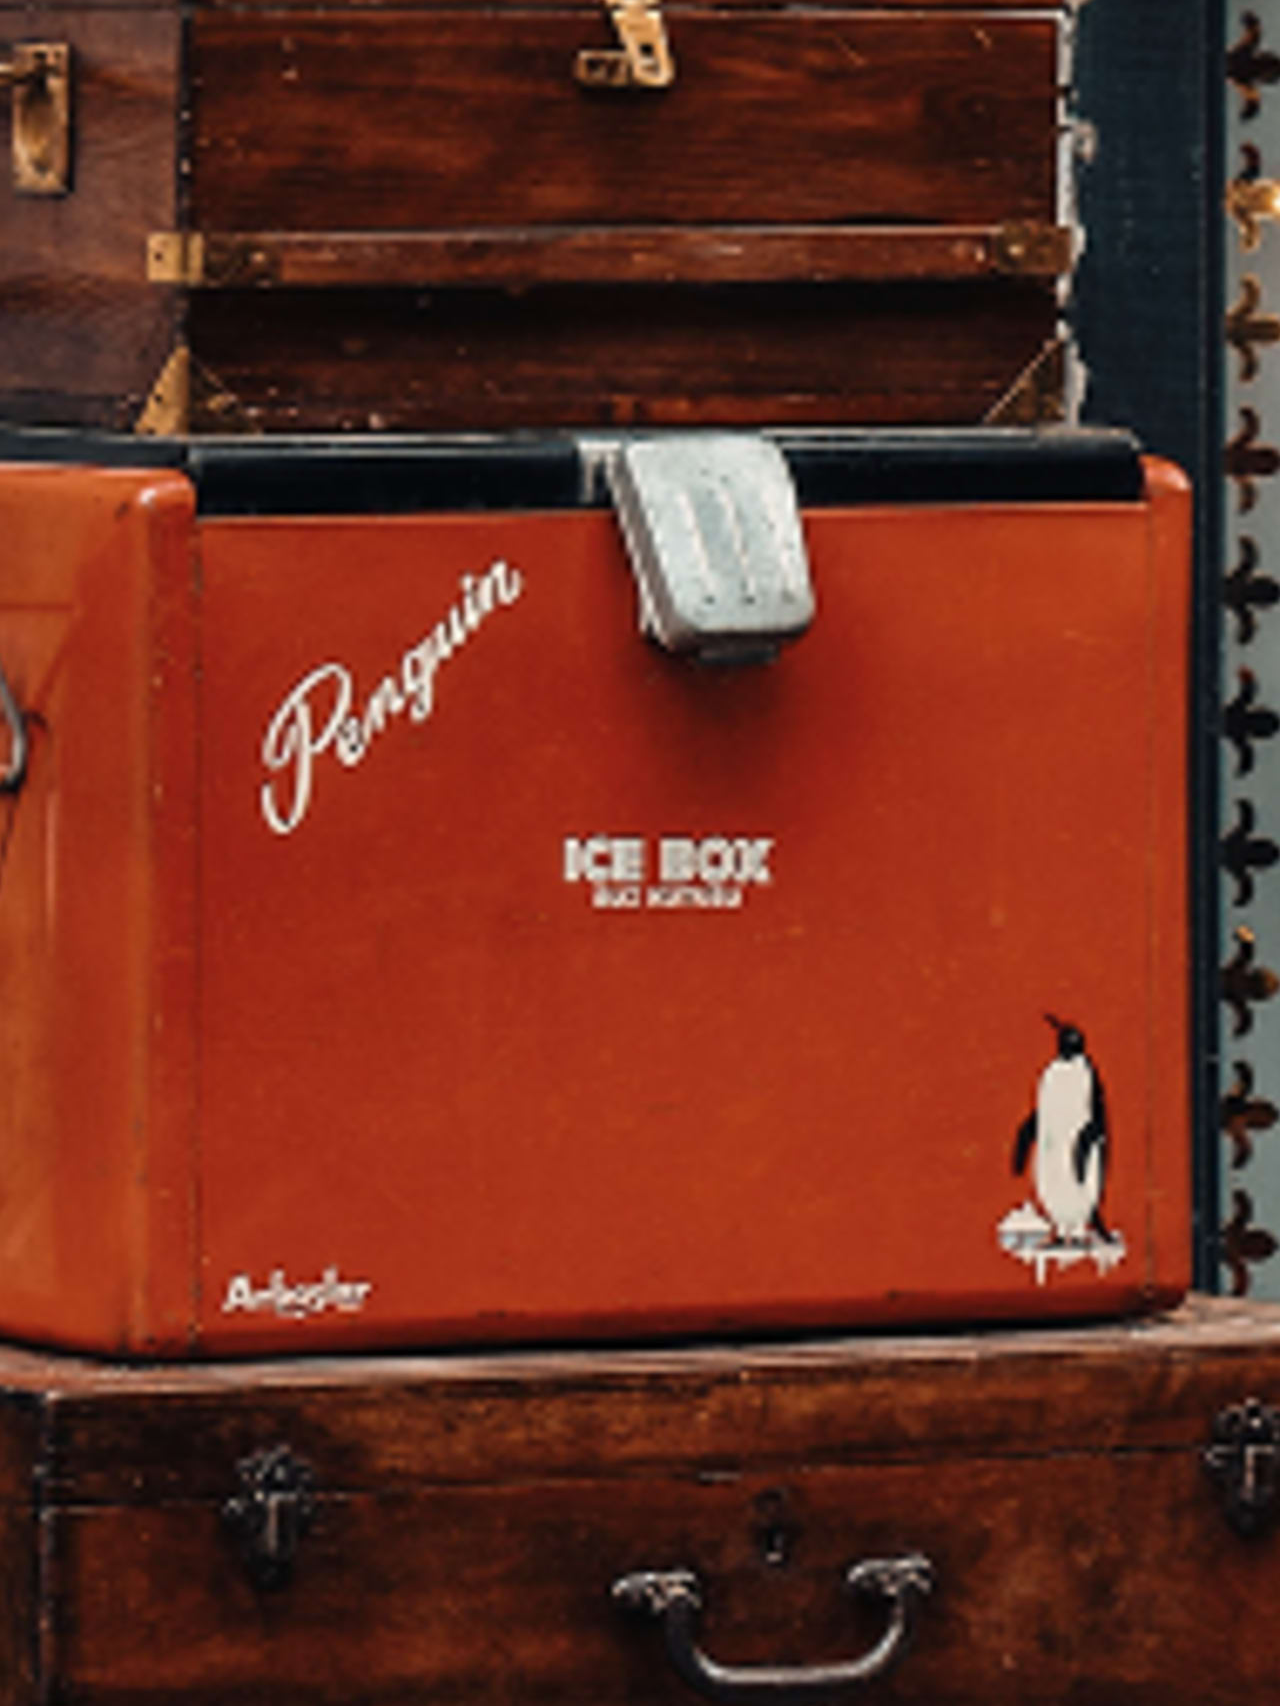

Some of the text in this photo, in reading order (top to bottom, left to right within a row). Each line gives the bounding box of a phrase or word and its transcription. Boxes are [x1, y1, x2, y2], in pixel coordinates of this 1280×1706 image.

[261, 559, 523, 835] Penguin
[563, 836, 776, 883] ICE BOX
